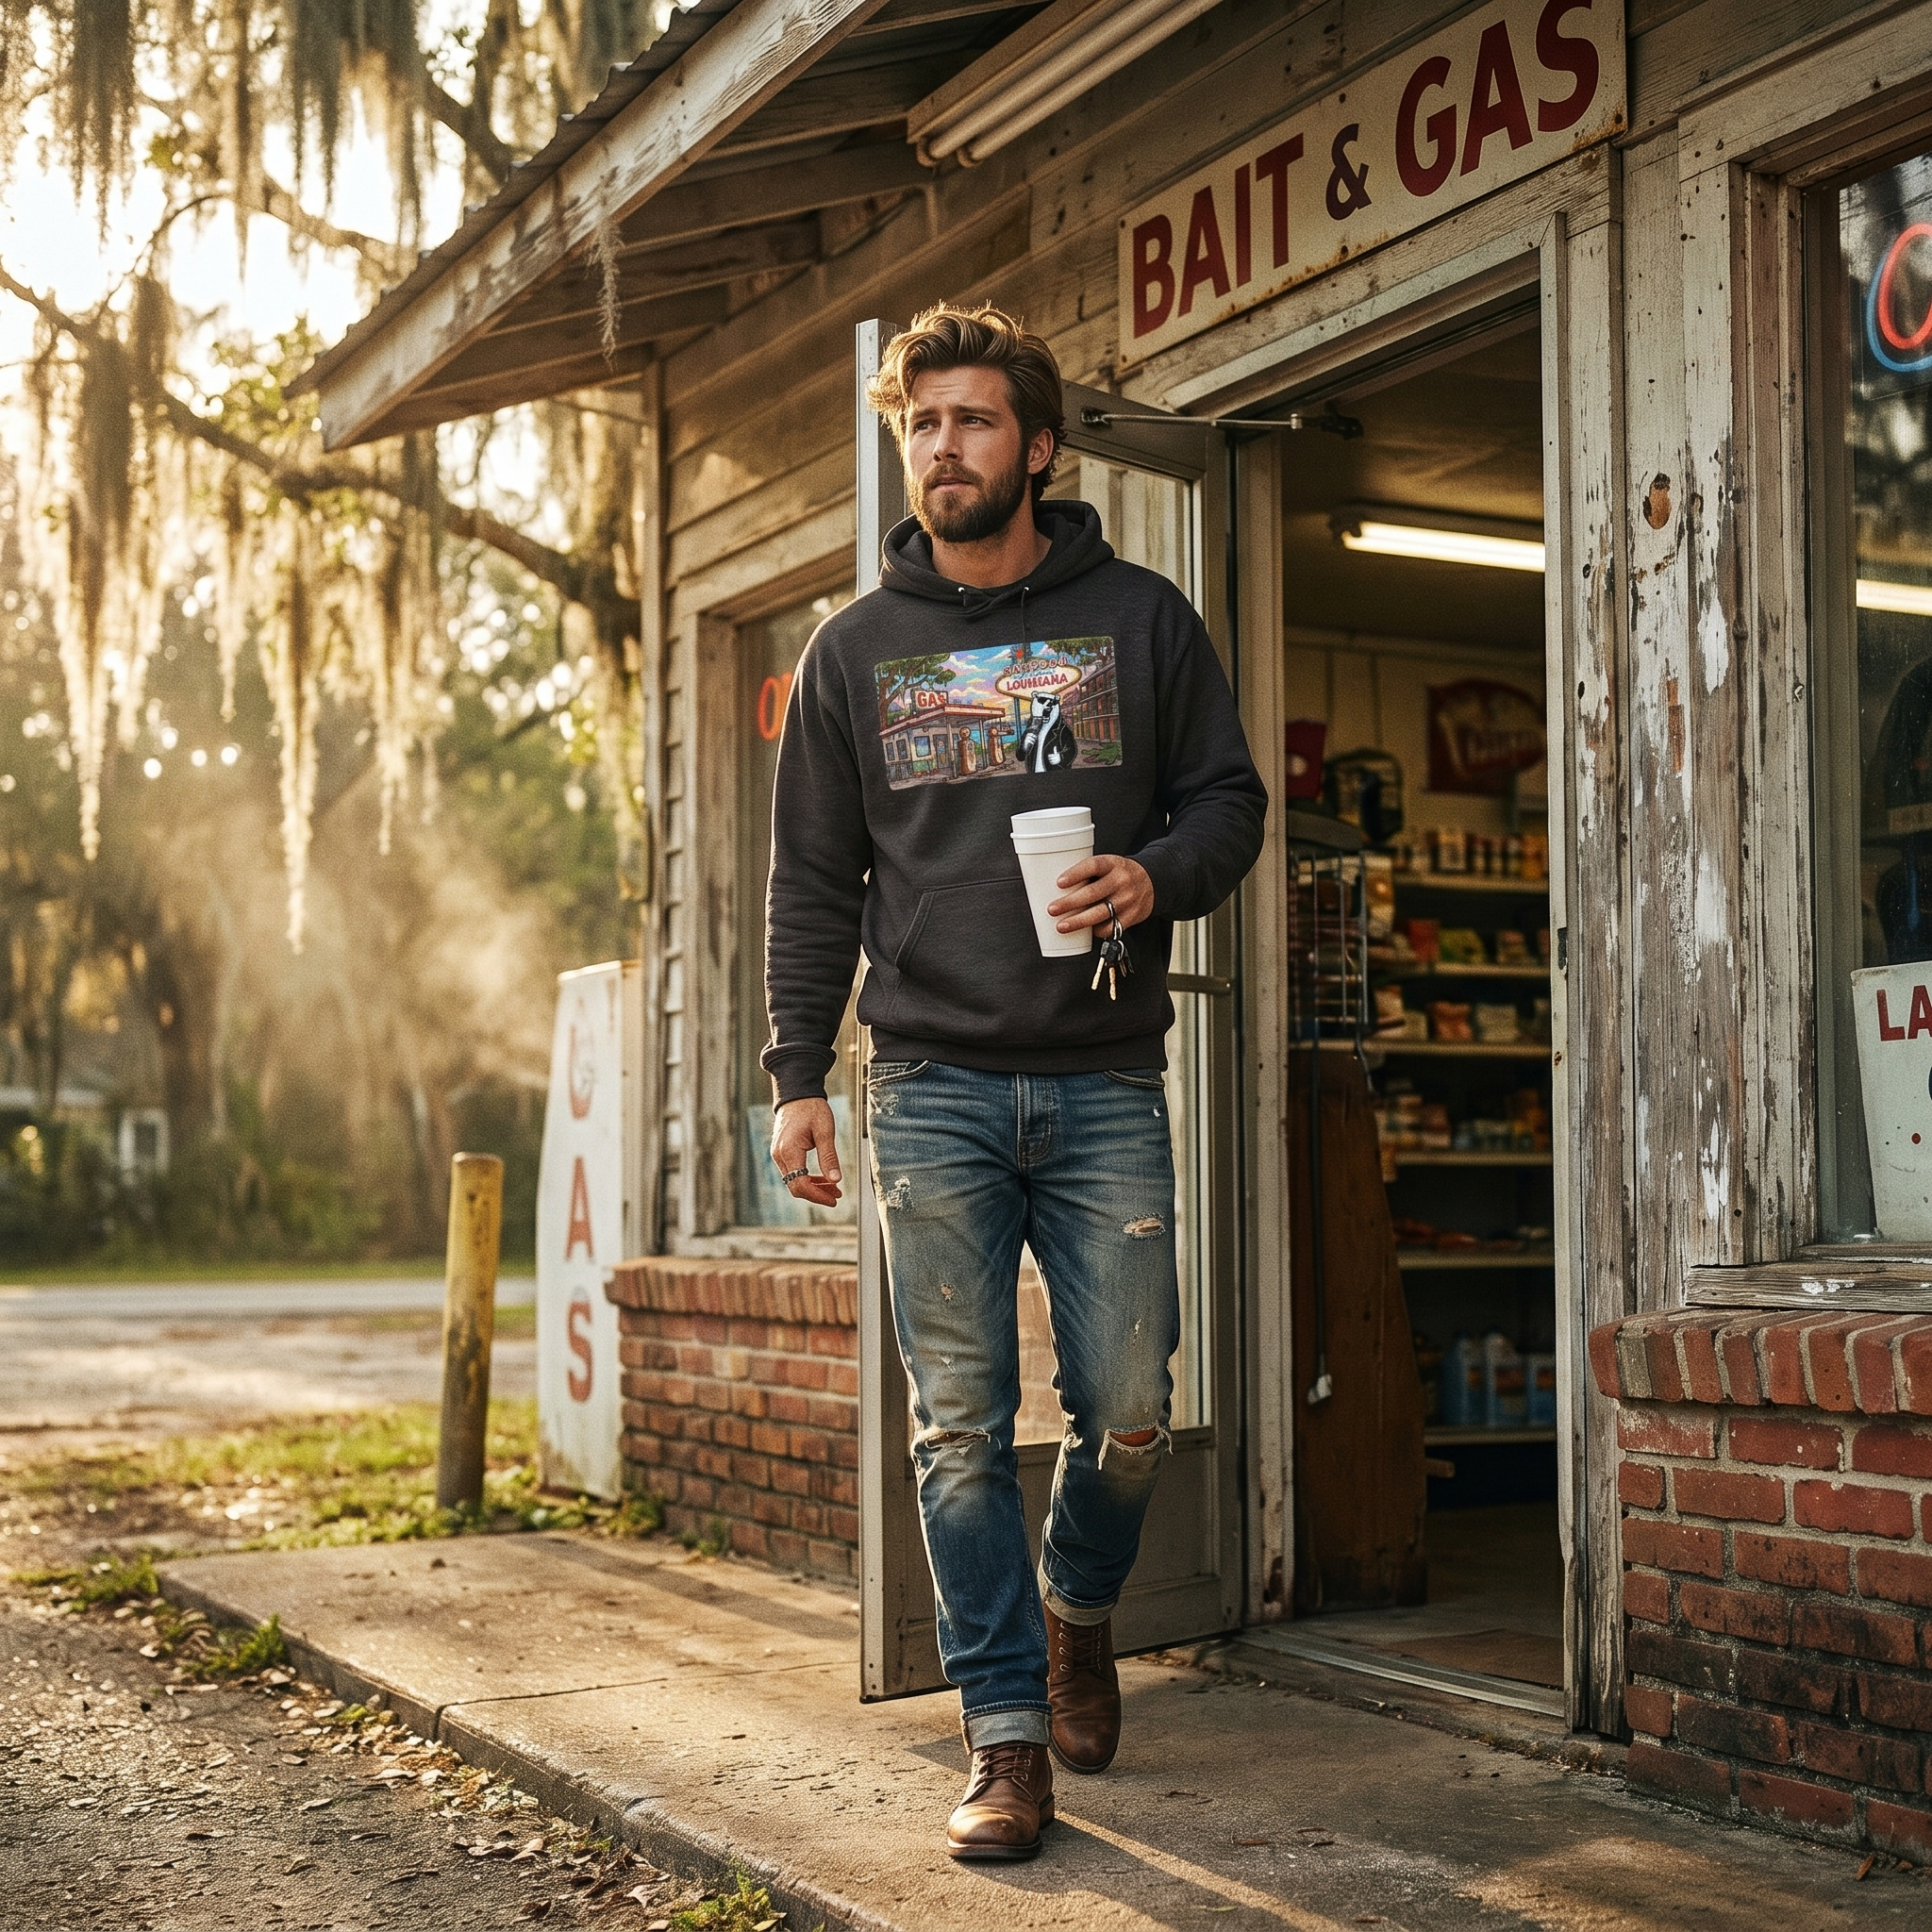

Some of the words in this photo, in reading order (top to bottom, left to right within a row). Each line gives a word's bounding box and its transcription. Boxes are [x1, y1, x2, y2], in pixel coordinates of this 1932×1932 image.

[1132, 132, 1304, 340] BAIT
[1325, 124, 1372, 221] &
[1394, 0, 1600, 197] GAS
[917, 691, 946, 708] GAS
